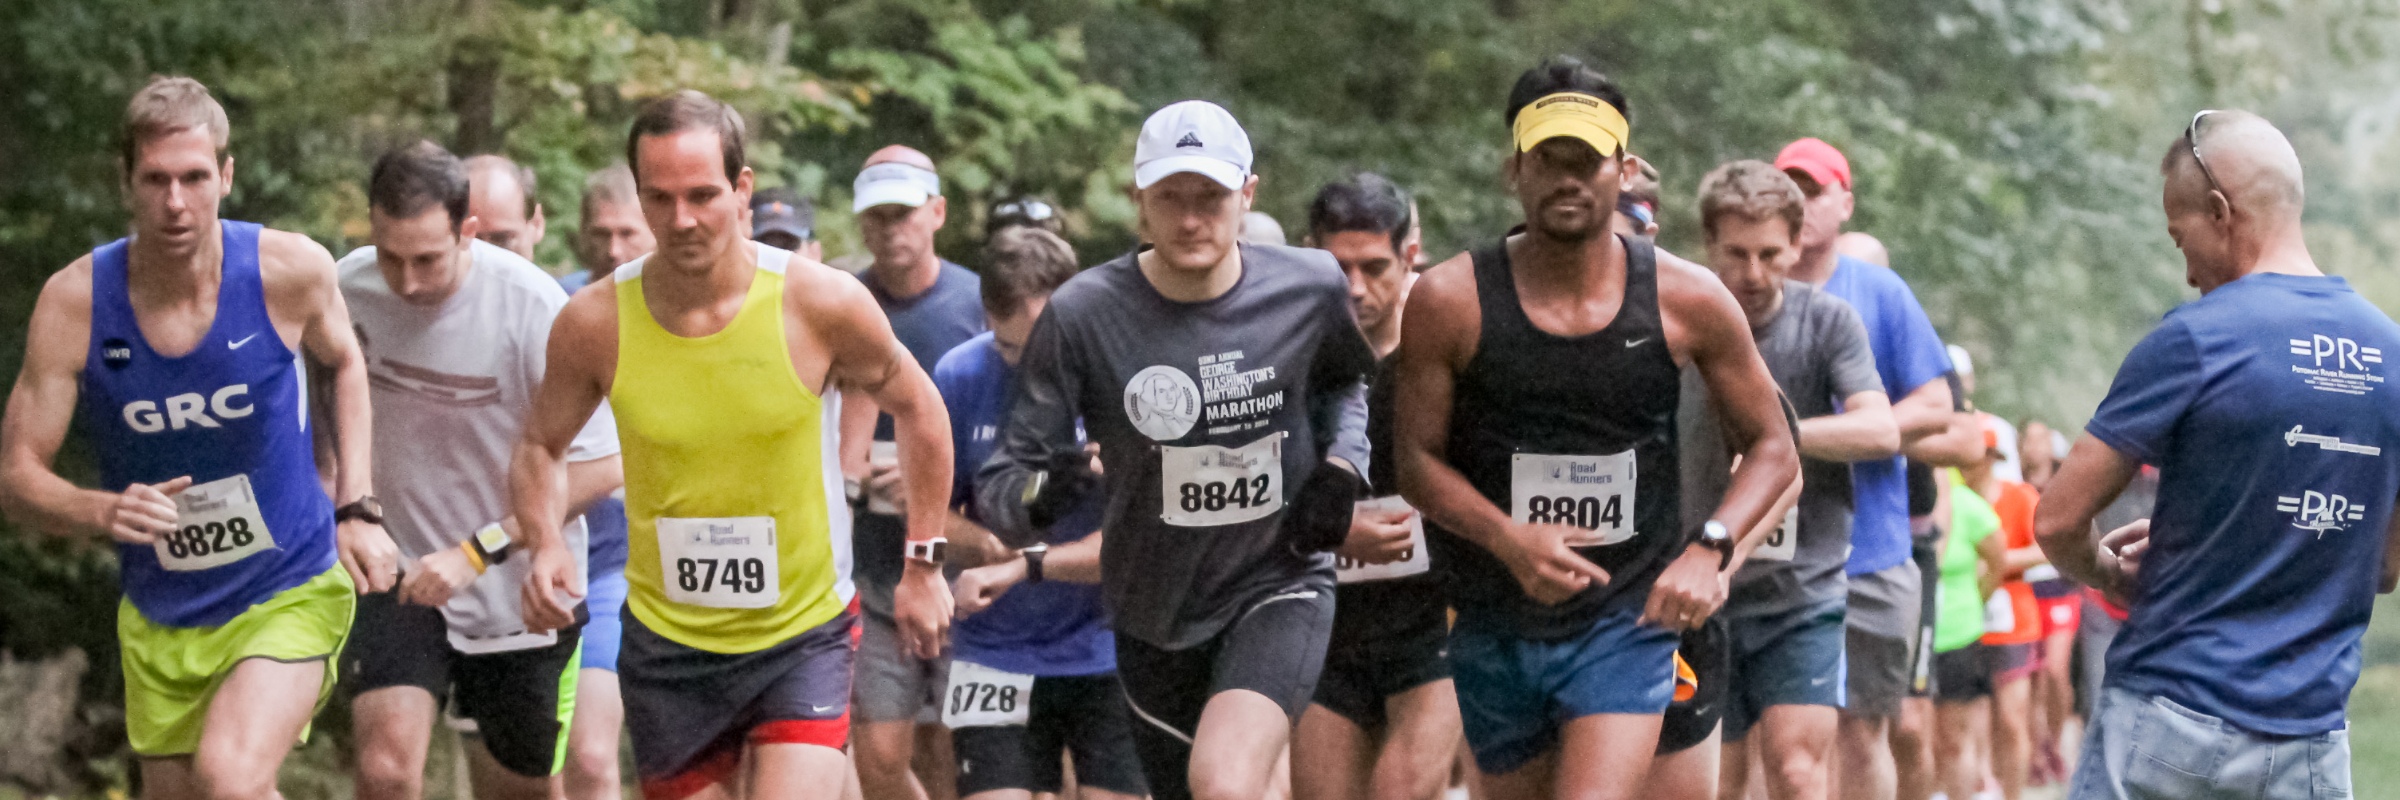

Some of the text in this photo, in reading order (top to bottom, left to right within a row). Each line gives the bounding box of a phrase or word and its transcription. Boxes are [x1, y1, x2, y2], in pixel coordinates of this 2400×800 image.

[1199, 361, 1237, 379] GEORGE
[1201, 366, 1276, 391] WASHINGTON'S
[122, 383, 254, 433] GRC
[1203, 383, 1254, 403] BIRTHDAY
[1206, 390, 1283, 421] MARATHON
[1570, 461, 1597, 473] Road
[1570, 473, 1612, 484] Runners
[1180, 473, 1271, 512] 8842
[1528, 494, 1623, 531] 8804
[164, 517, 254, 559] 8828
[676, 557, 765, 593] 8749
[950, 682, 1018, 716] 8728
